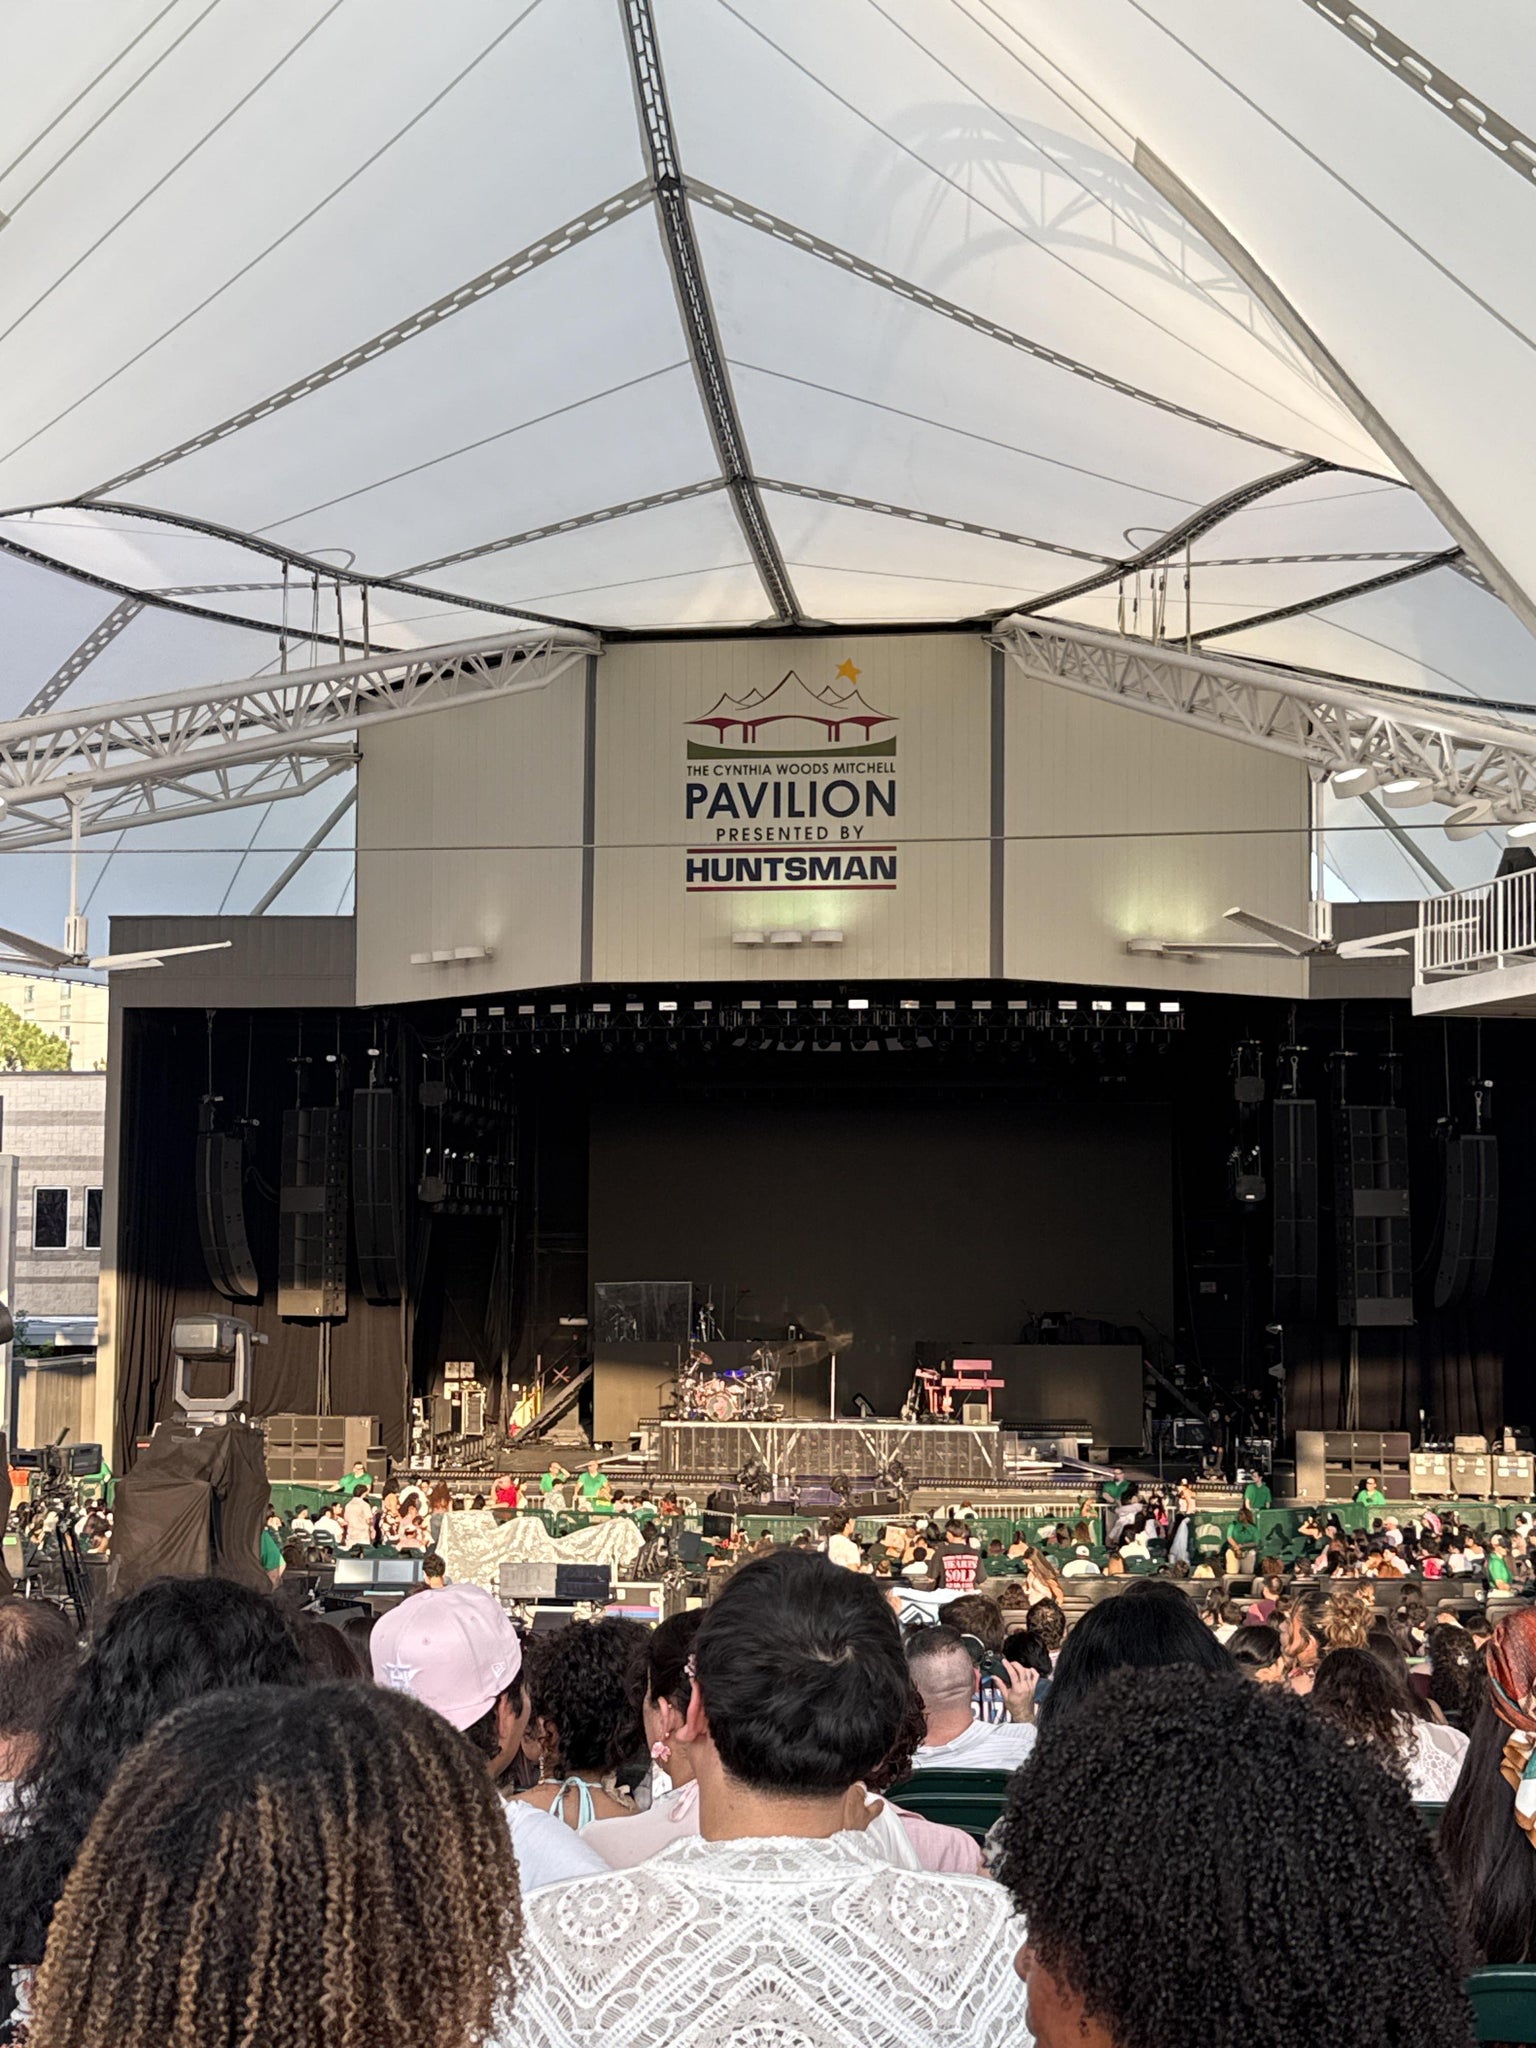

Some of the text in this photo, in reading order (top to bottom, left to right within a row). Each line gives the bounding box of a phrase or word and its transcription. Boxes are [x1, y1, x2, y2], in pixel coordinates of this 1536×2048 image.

[687, 762, 896, 776] THE CYNTHIA WOODS MITCHELL
[686, 780, 896, 819] PAVILION
[716, 825, 864, 842] PRESENTED BY
[686, 856, 897, 882] HUNTSMAN
